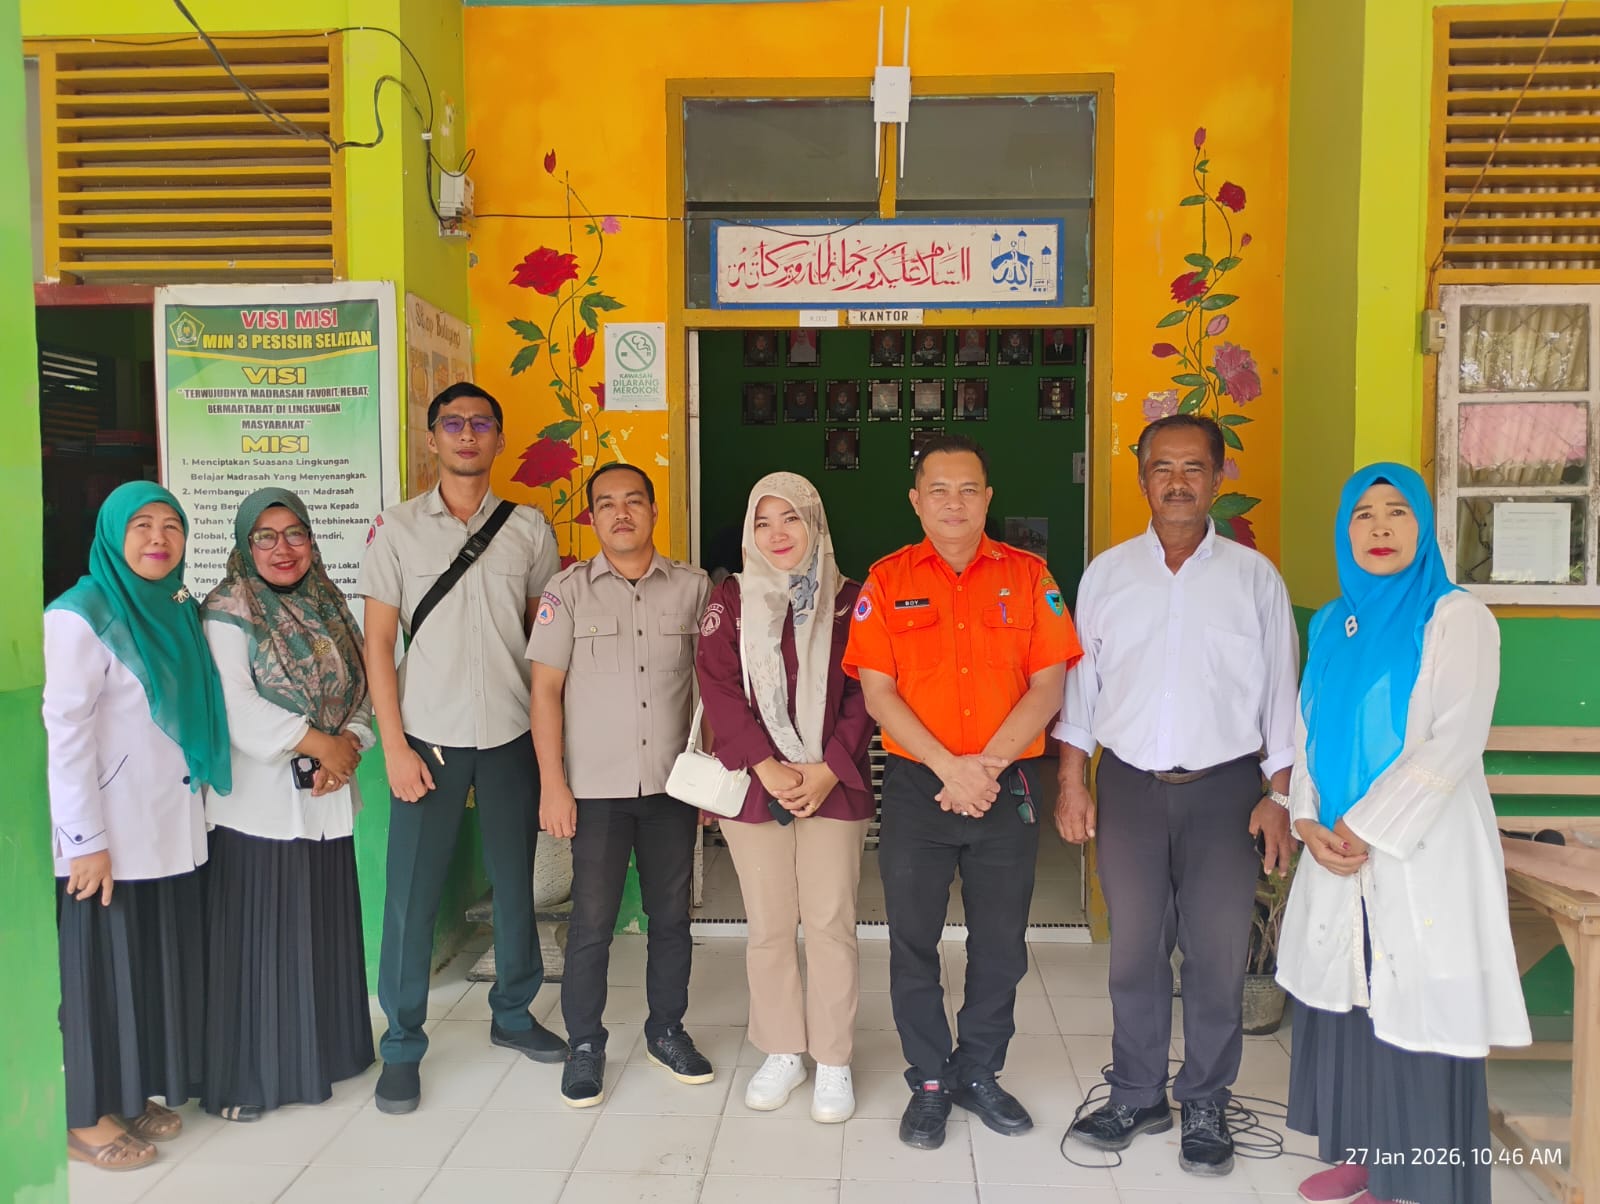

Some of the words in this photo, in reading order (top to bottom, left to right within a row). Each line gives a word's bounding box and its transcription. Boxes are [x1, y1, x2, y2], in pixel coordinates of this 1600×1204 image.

[241, 310, 289, 330] VISI
[295, 308, 338, 328] MISI
[860, 311, 909, 322] KANTOR
[203, 333, 234, 349] MIN
[237, 334, 248, 349] 3
[251, 333, 313, 349] PESISIR
[315, 331, 372, 348] SELATAN
[242, 367, 307, 385] VISI
[613, 379, 660, 387] DILARANG
[250, 388, 305, 399] MADRASAH
[613, 386, 660, 394] MEROKOK
[208, 403, 274, 414] BERMARTABAT
[275, 404, 287, 414] DI
[288, 402, 341, 414] LINGKUNGAN
[241, 419, 305, 430] MASYARAKAT
[241, 435, 309, 453] MISI
[182, 458, 189, 466] 1.
[191, 458, 250, 468] Menciptakan
[252, 458, 294, 466] Suasana
[296, 458, 350, 468] Lingkungan
[191, 473, 225, 482] Belajar
[227, 473, 271, 481] Madrasah
[273, 473, 297, 482] Yang
[300, 472, 368, 482] Menyenangkan.
[182, 488, 191, 496] 2.
[194, 487, 250, 498] Membangun
[313, 487, 354, 496] Madrasah
[194, 503, 218, 512] Yang
[330, 502, 360, 511] Kepada
[194, 517, 224, 525] Tuhan
[310, 516, 370, 526] rkebhinekaan
[194, 532, 228, 541] Global,
[194, 546, 230, 556] Kreatif,
[338, 561, 360, 569] Lokal
[194, 576, 218, 585] Yang
